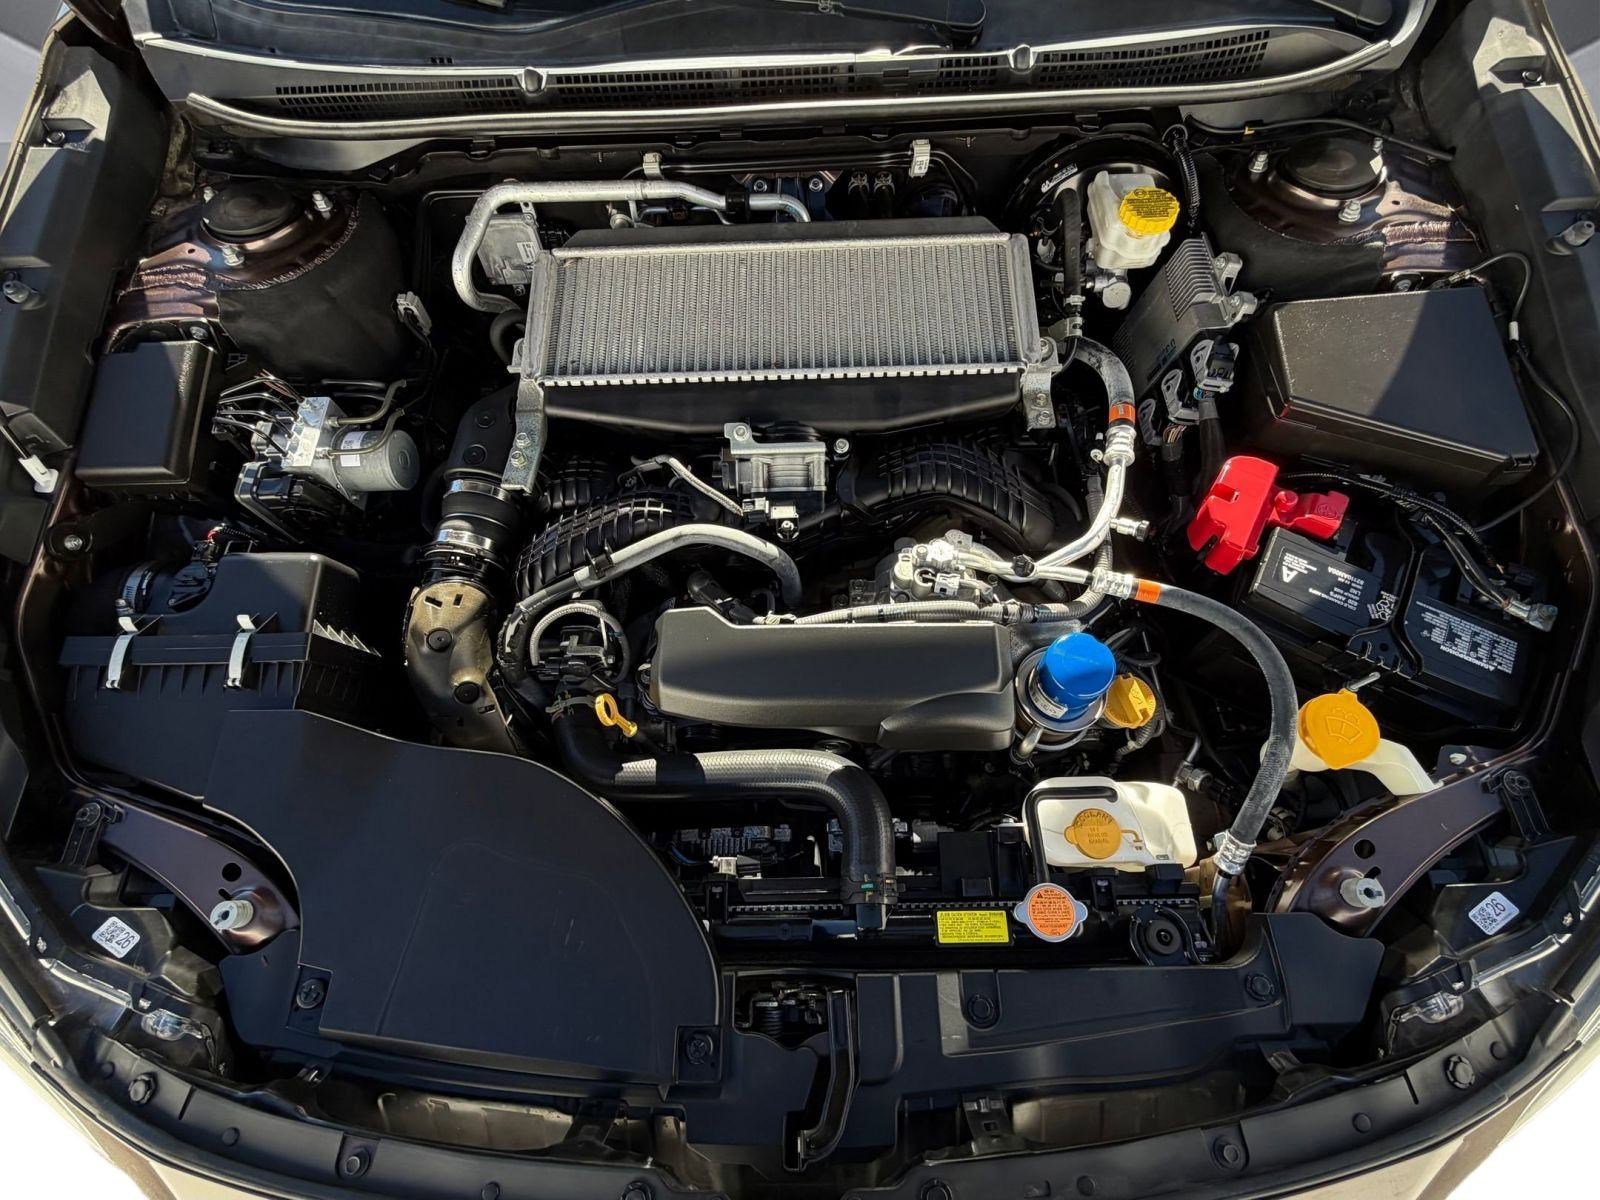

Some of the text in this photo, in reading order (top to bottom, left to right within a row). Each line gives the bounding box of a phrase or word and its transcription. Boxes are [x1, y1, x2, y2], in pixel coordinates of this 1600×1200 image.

[1075, 811, 1113, 829] COOLANT
[1485, 898, 1506, 917] 26
[115, 931, 135, 949] 26
